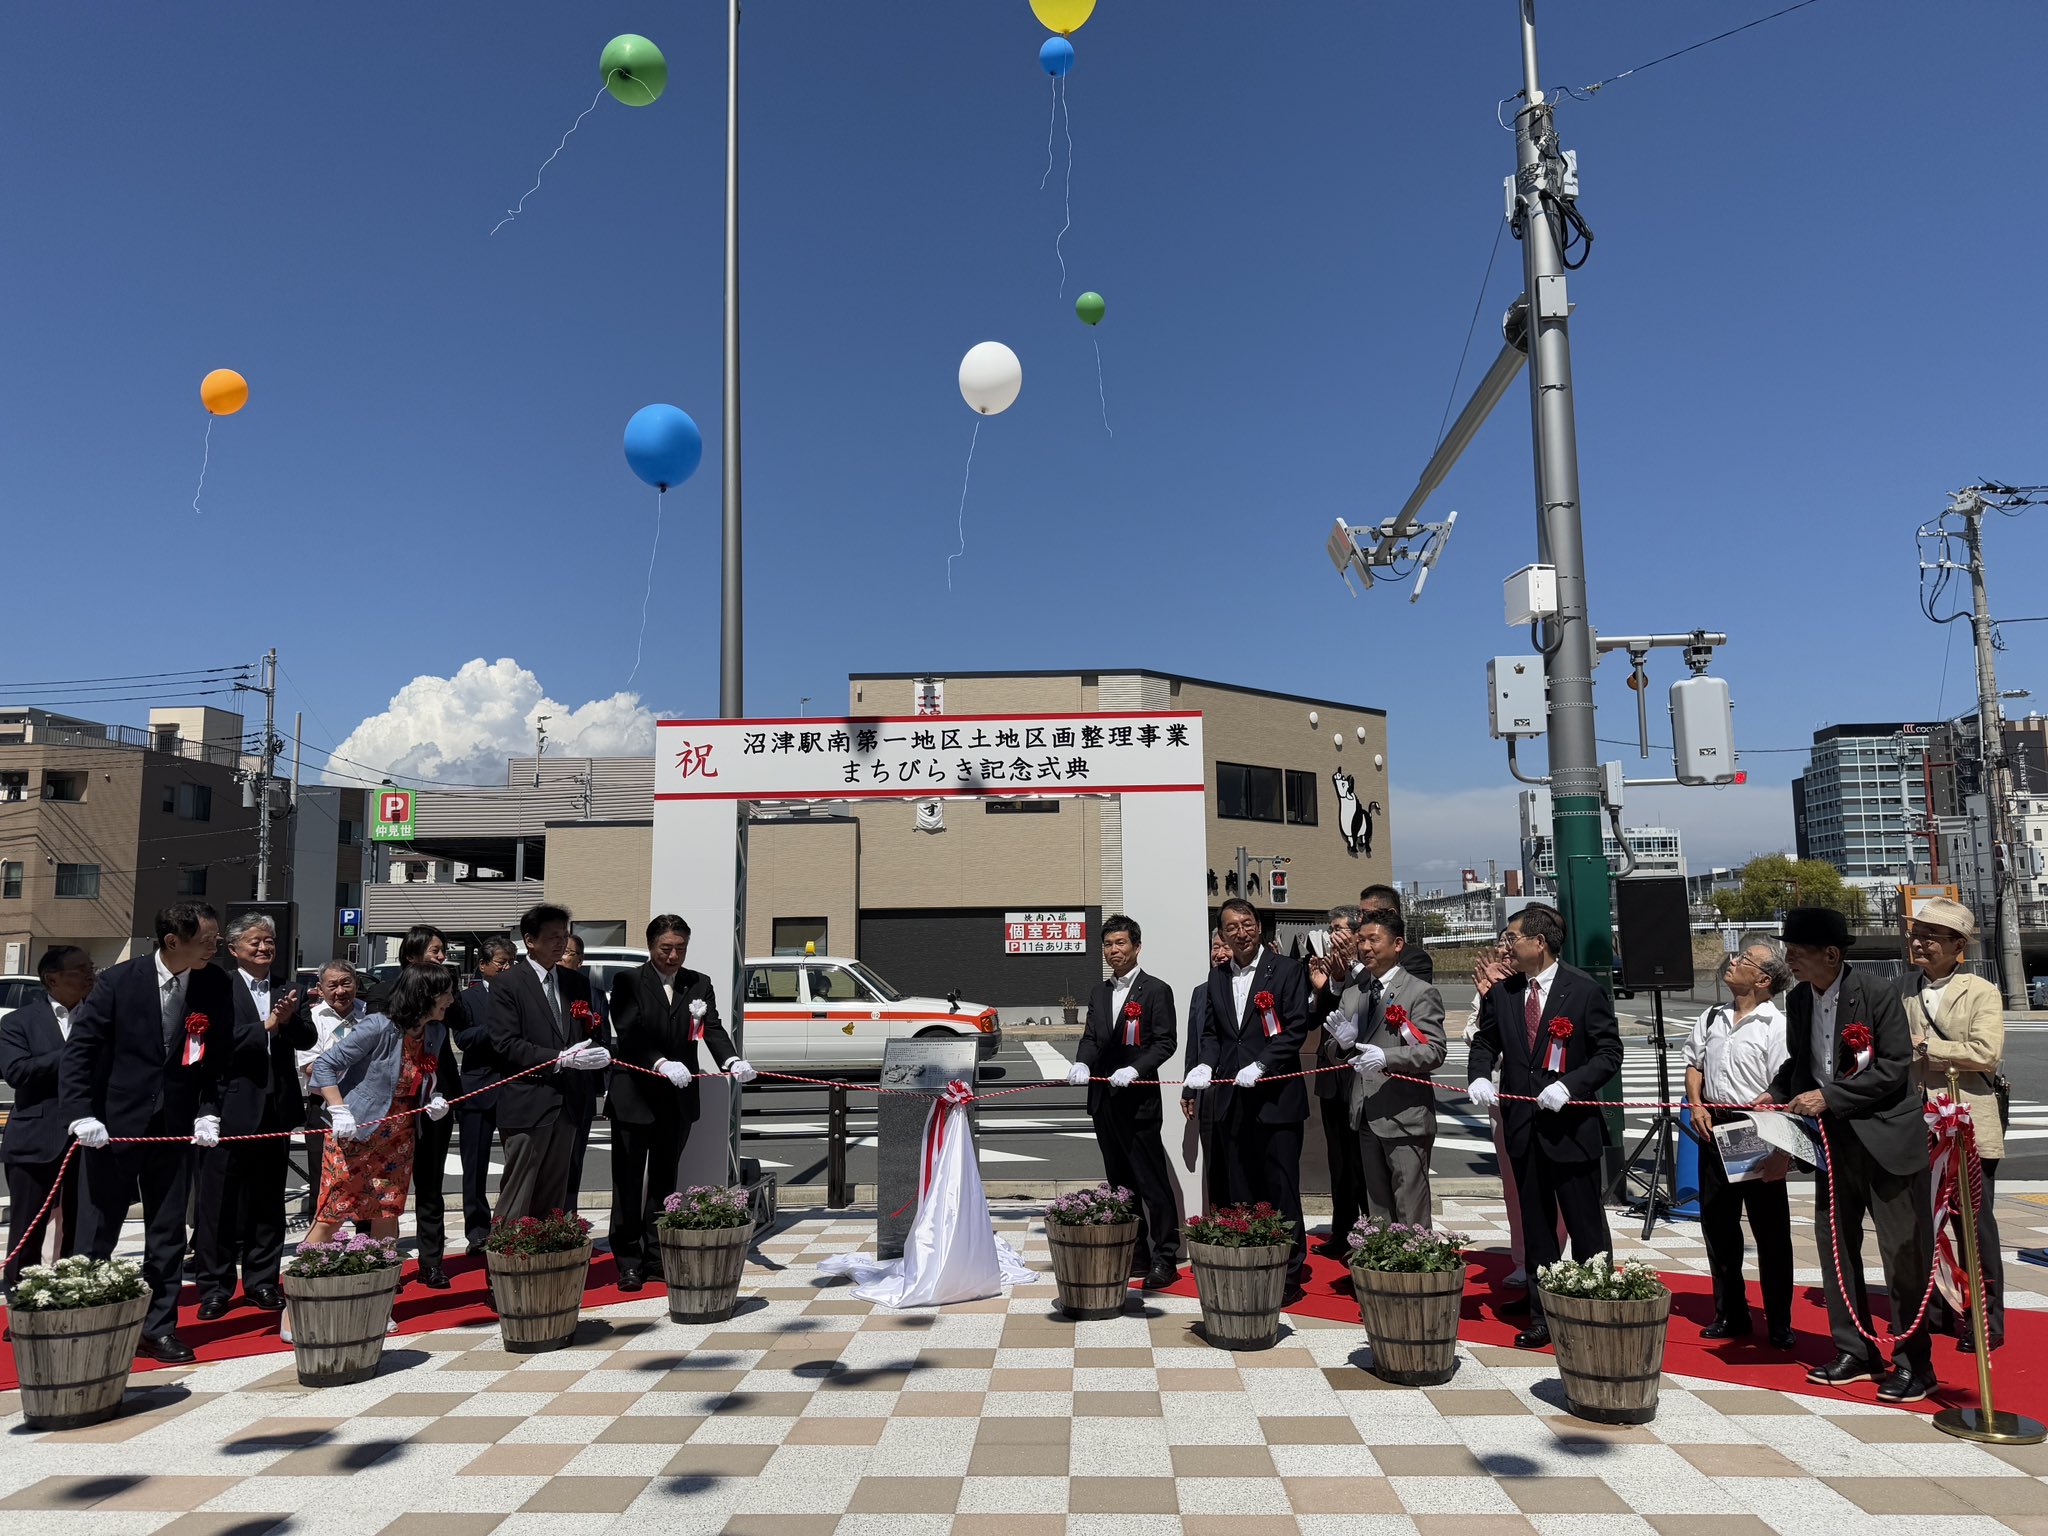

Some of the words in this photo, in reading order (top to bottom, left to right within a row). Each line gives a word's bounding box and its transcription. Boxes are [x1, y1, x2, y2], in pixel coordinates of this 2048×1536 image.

[743, 723, 1190, 754] 沼津駅南第一地区土地区画整理事業
[675, 741, 718, 778] 祝
[842, 756, 1090, 783] まちびらき記念式典
[385, 796, 404, 819] P
[375, 824, 412, 837] 仲見世
[344, 910, 355, 923] P
[1009, 923, 1081, 939] 個室完備
[1011, 942, 1019, 951] P
[1022, 942, 1083, 952] 11台あります
